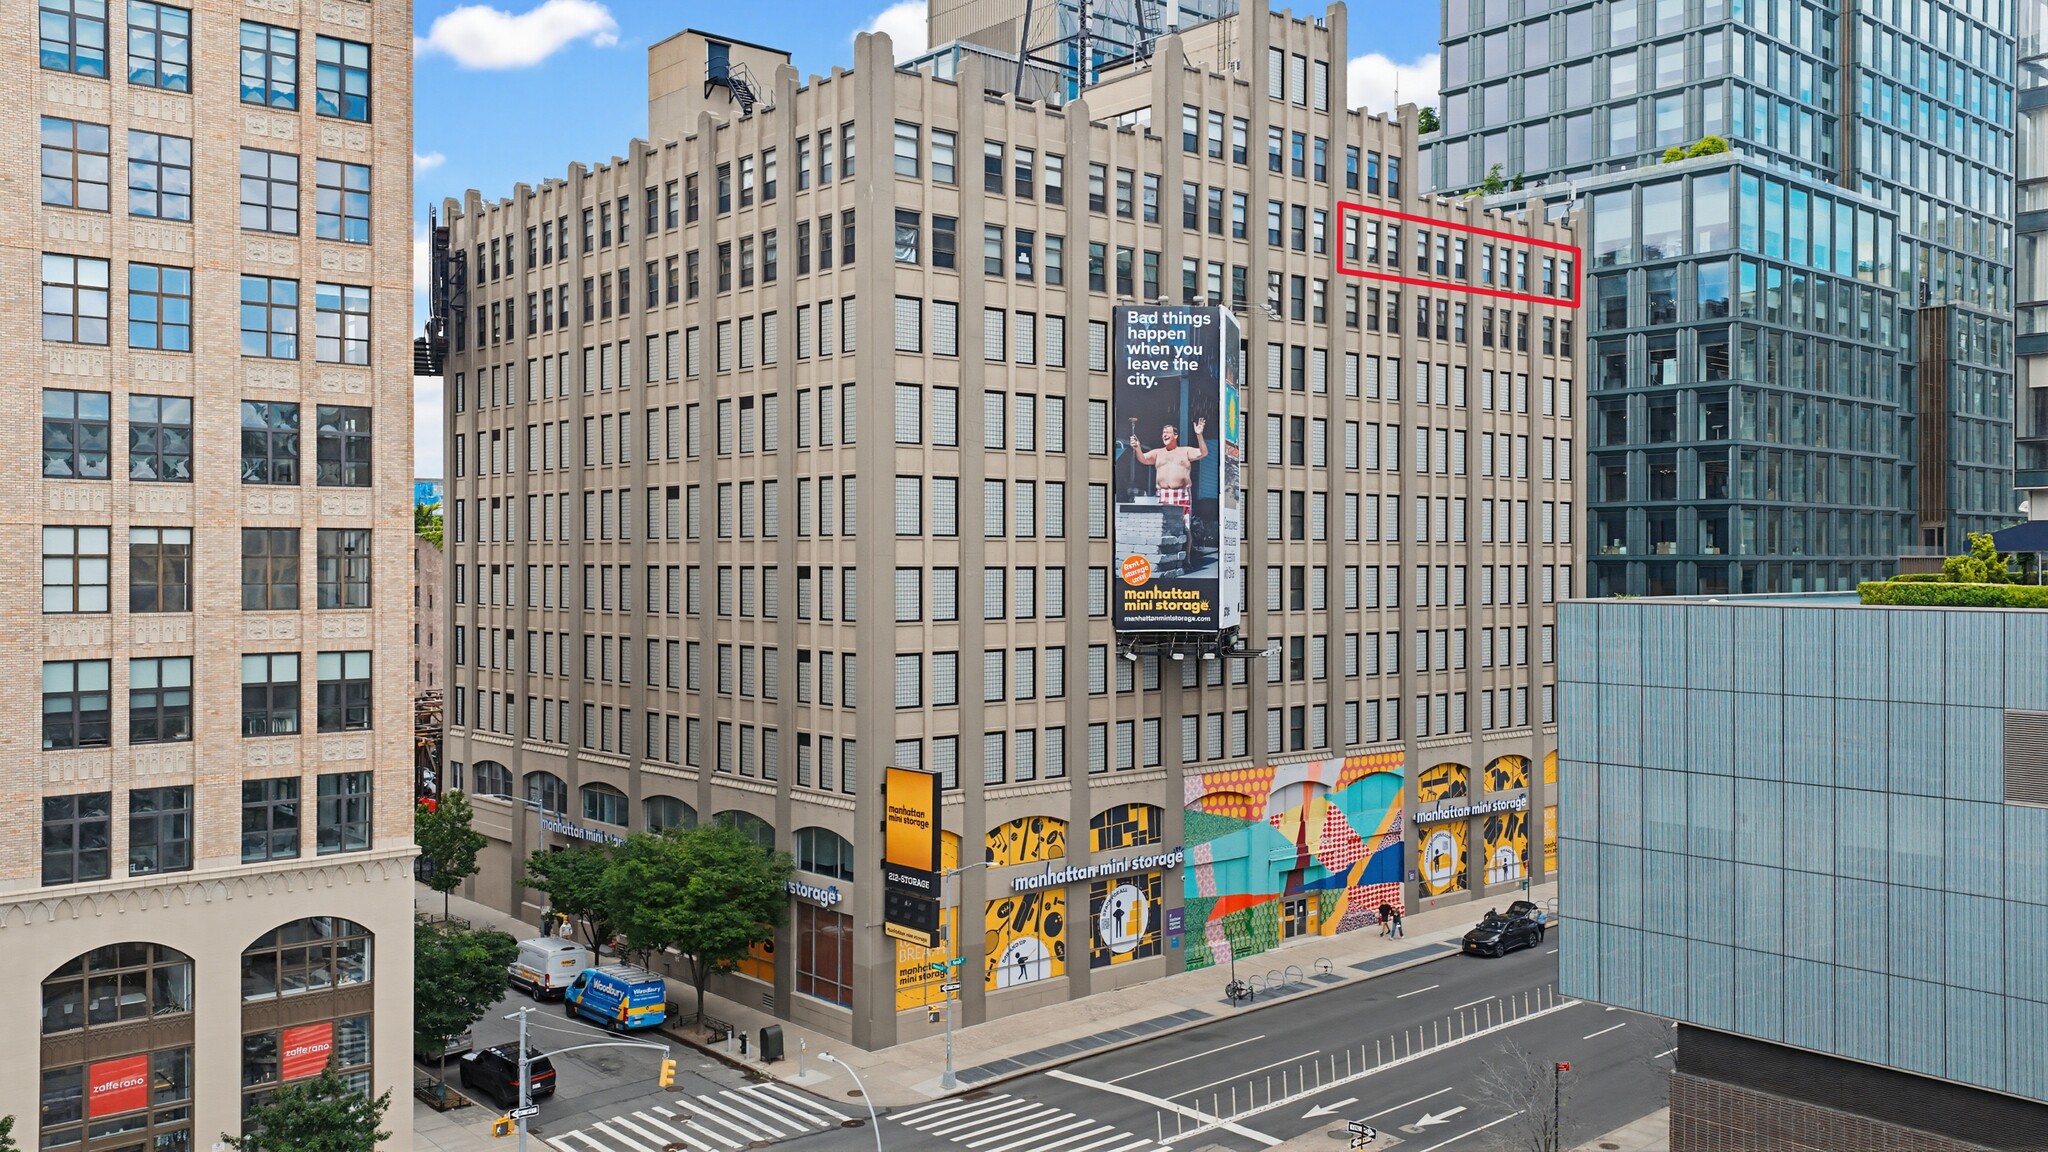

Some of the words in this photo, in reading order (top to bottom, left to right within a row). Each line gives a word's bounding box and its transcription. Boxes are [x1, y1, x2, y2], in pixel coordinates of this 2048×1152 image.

[1128, 311, 1158, 324] Bad
[1162, 311, 1211, 328] things
[1127, 327, 1186, 342] happen
[1127, 342, 1170, 355] when
[1174, 345, 1203, 358] you
[1127, 357, 1169, 370] leave
[1173, 358, 1199, 370] the
[1127, 373, 1158, 388] city.
[1124, 584, 1200, 600] manhattan
[1124, 600, 1153, 611] mini
[1155, 600, 1210, 614] storage
[889, 804, 925, 818] manhattan
[1417, 801, 1470, 823] manhattan
[1471, 801, 1491, 814] mini
[1493, 794, 1527, 811] storage
[542, 813, 585, 839] manhattan
[889, 814, 902, 823] mini
[904, 817, 929, 830] storage
[1014, 862, 1096, 891] manhattan
[1100, 857, 1129, 876] mini
[1132, 847, 1184, 869] storage
[888, 872, 930, 889] 212-STORAGE
[788, 881, 837, 907] storage
[899, 974, 917, 985] mini
[593, 978, 625, 1001] Woodbury
[633, 986, 661, 995] Woodbury
[285, 1042, 330, 1057] zafferano
[93, 1077, 144, 1093] zafferano
